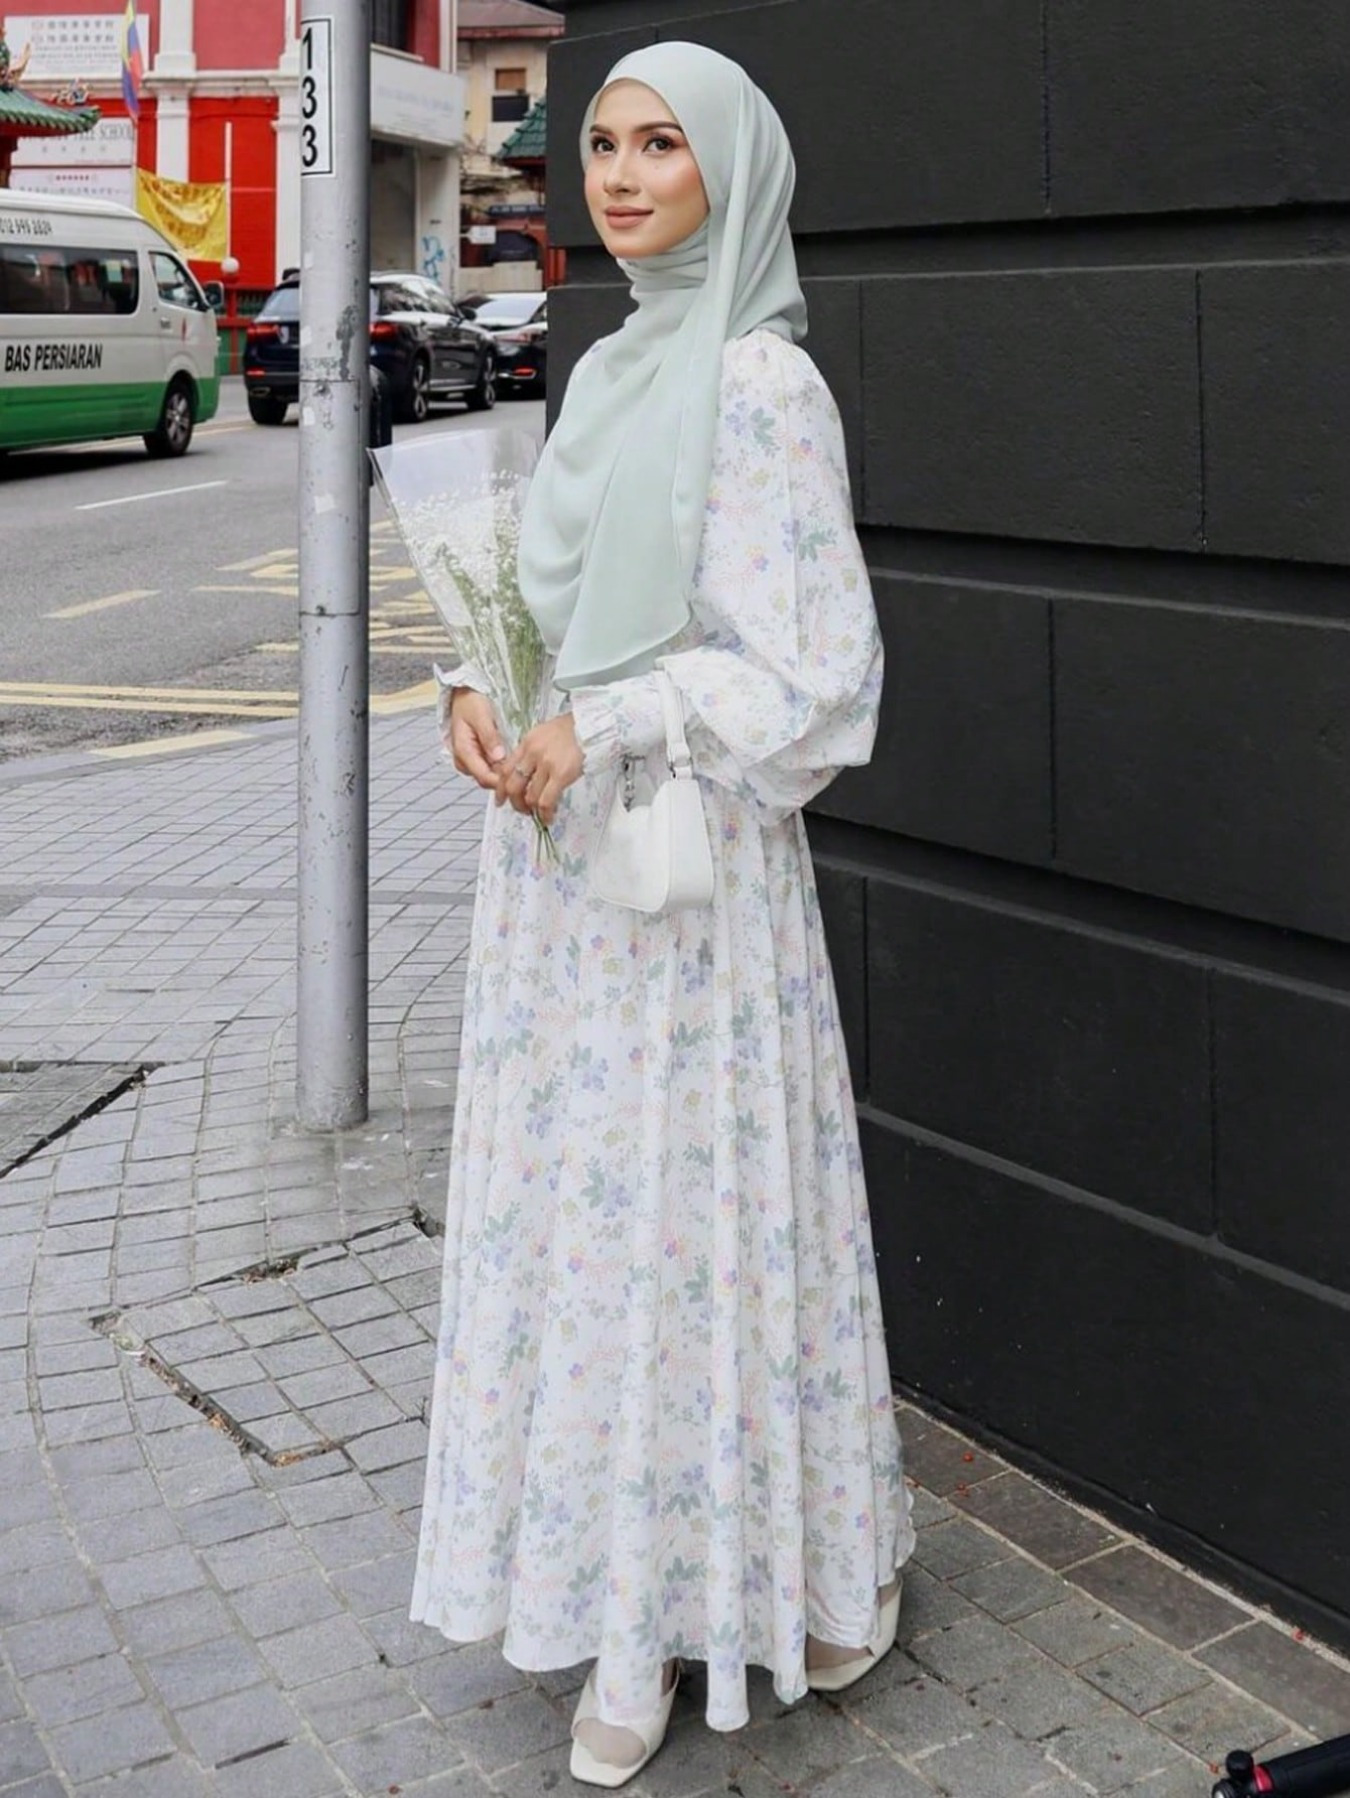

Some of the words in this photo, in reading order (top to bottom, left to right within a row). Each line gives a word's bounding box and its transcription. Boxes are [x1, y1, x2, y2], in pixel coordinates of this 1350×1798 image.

[302, 27, 318, 167] 133
[4, 344, 31, 372] BAS
[34, 343, 103, 371] PERSIARAN
